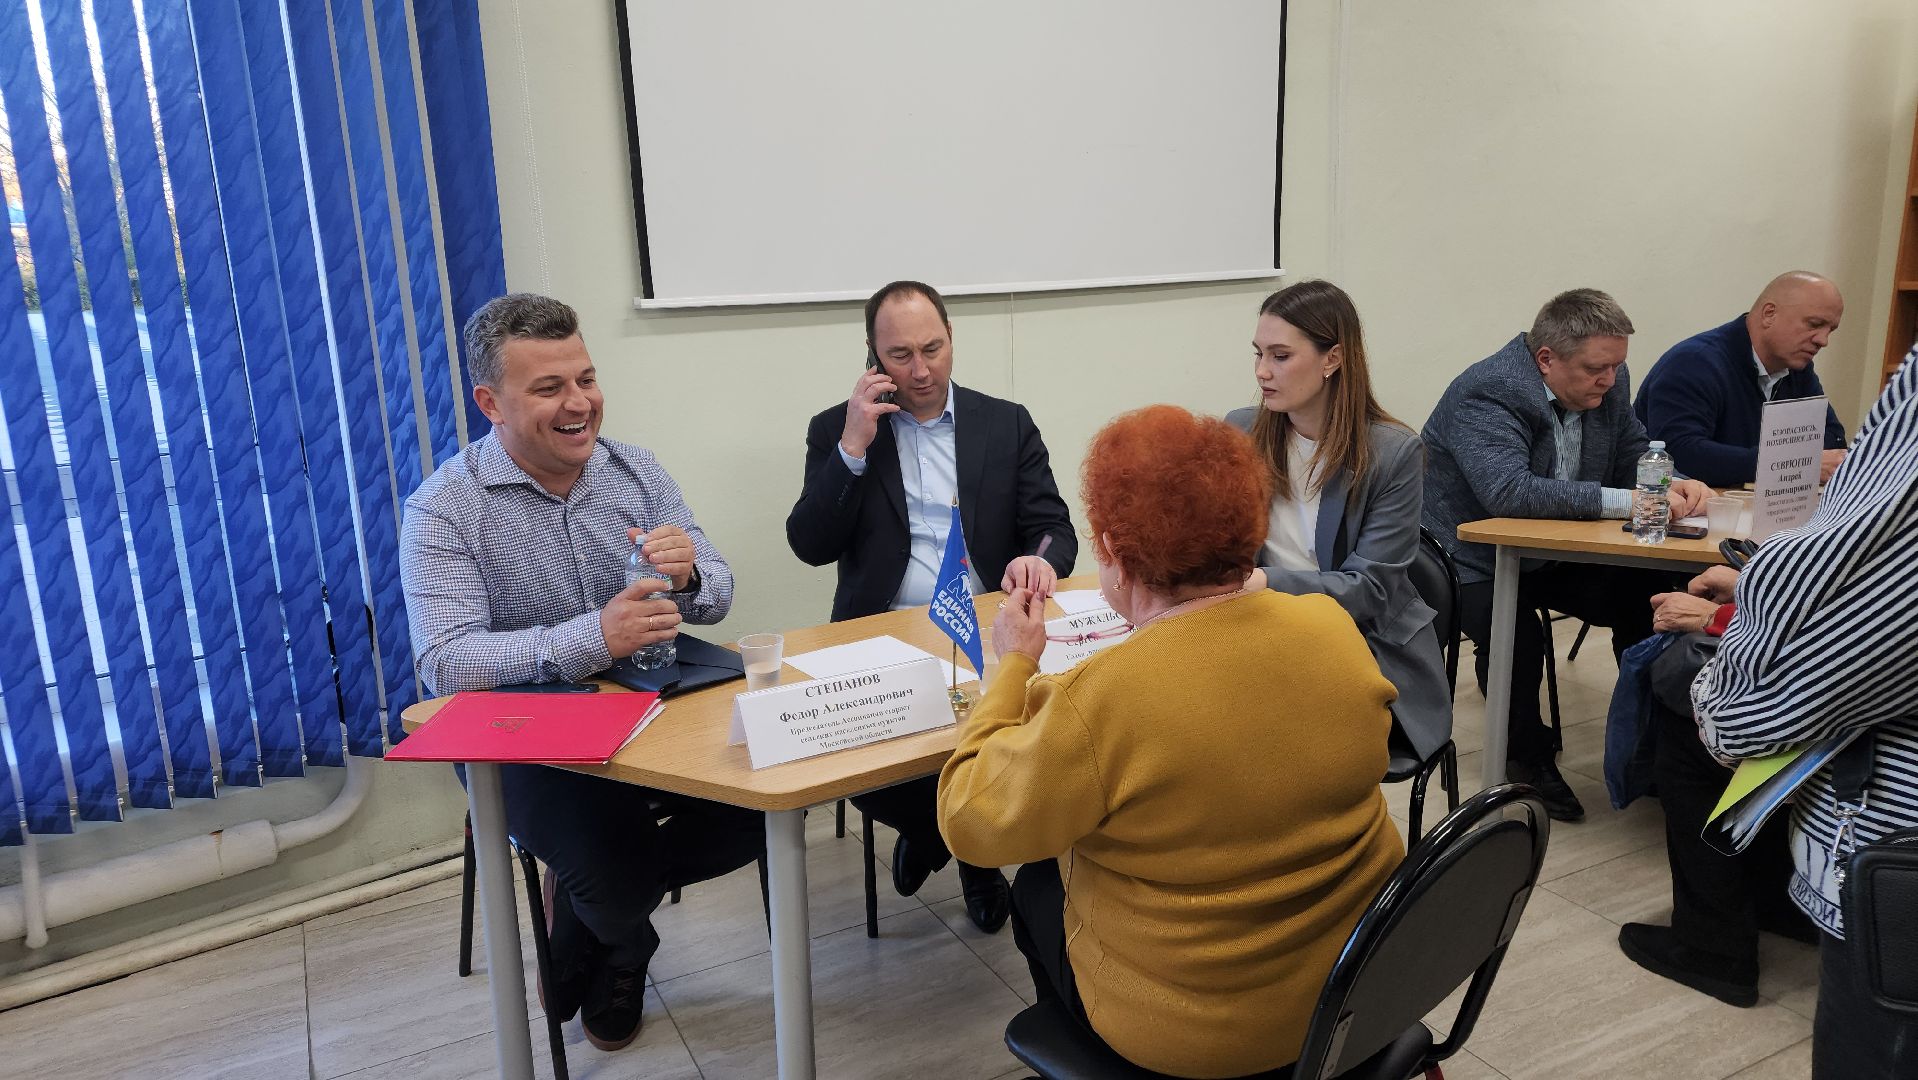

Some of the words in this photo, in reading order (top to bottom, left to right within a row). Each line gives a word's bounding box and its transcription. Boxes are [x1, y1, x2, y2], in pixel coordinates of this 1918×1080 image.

[931, 599, 971, 644] РОССИЯ
[937, 589, 974, 634] ЕДИНАЯ
[779, 708, 819, 723] Федор
[822, 687, 914, 716] Александрович
[805, 673, 881, 698] СТЕПАНОВ
